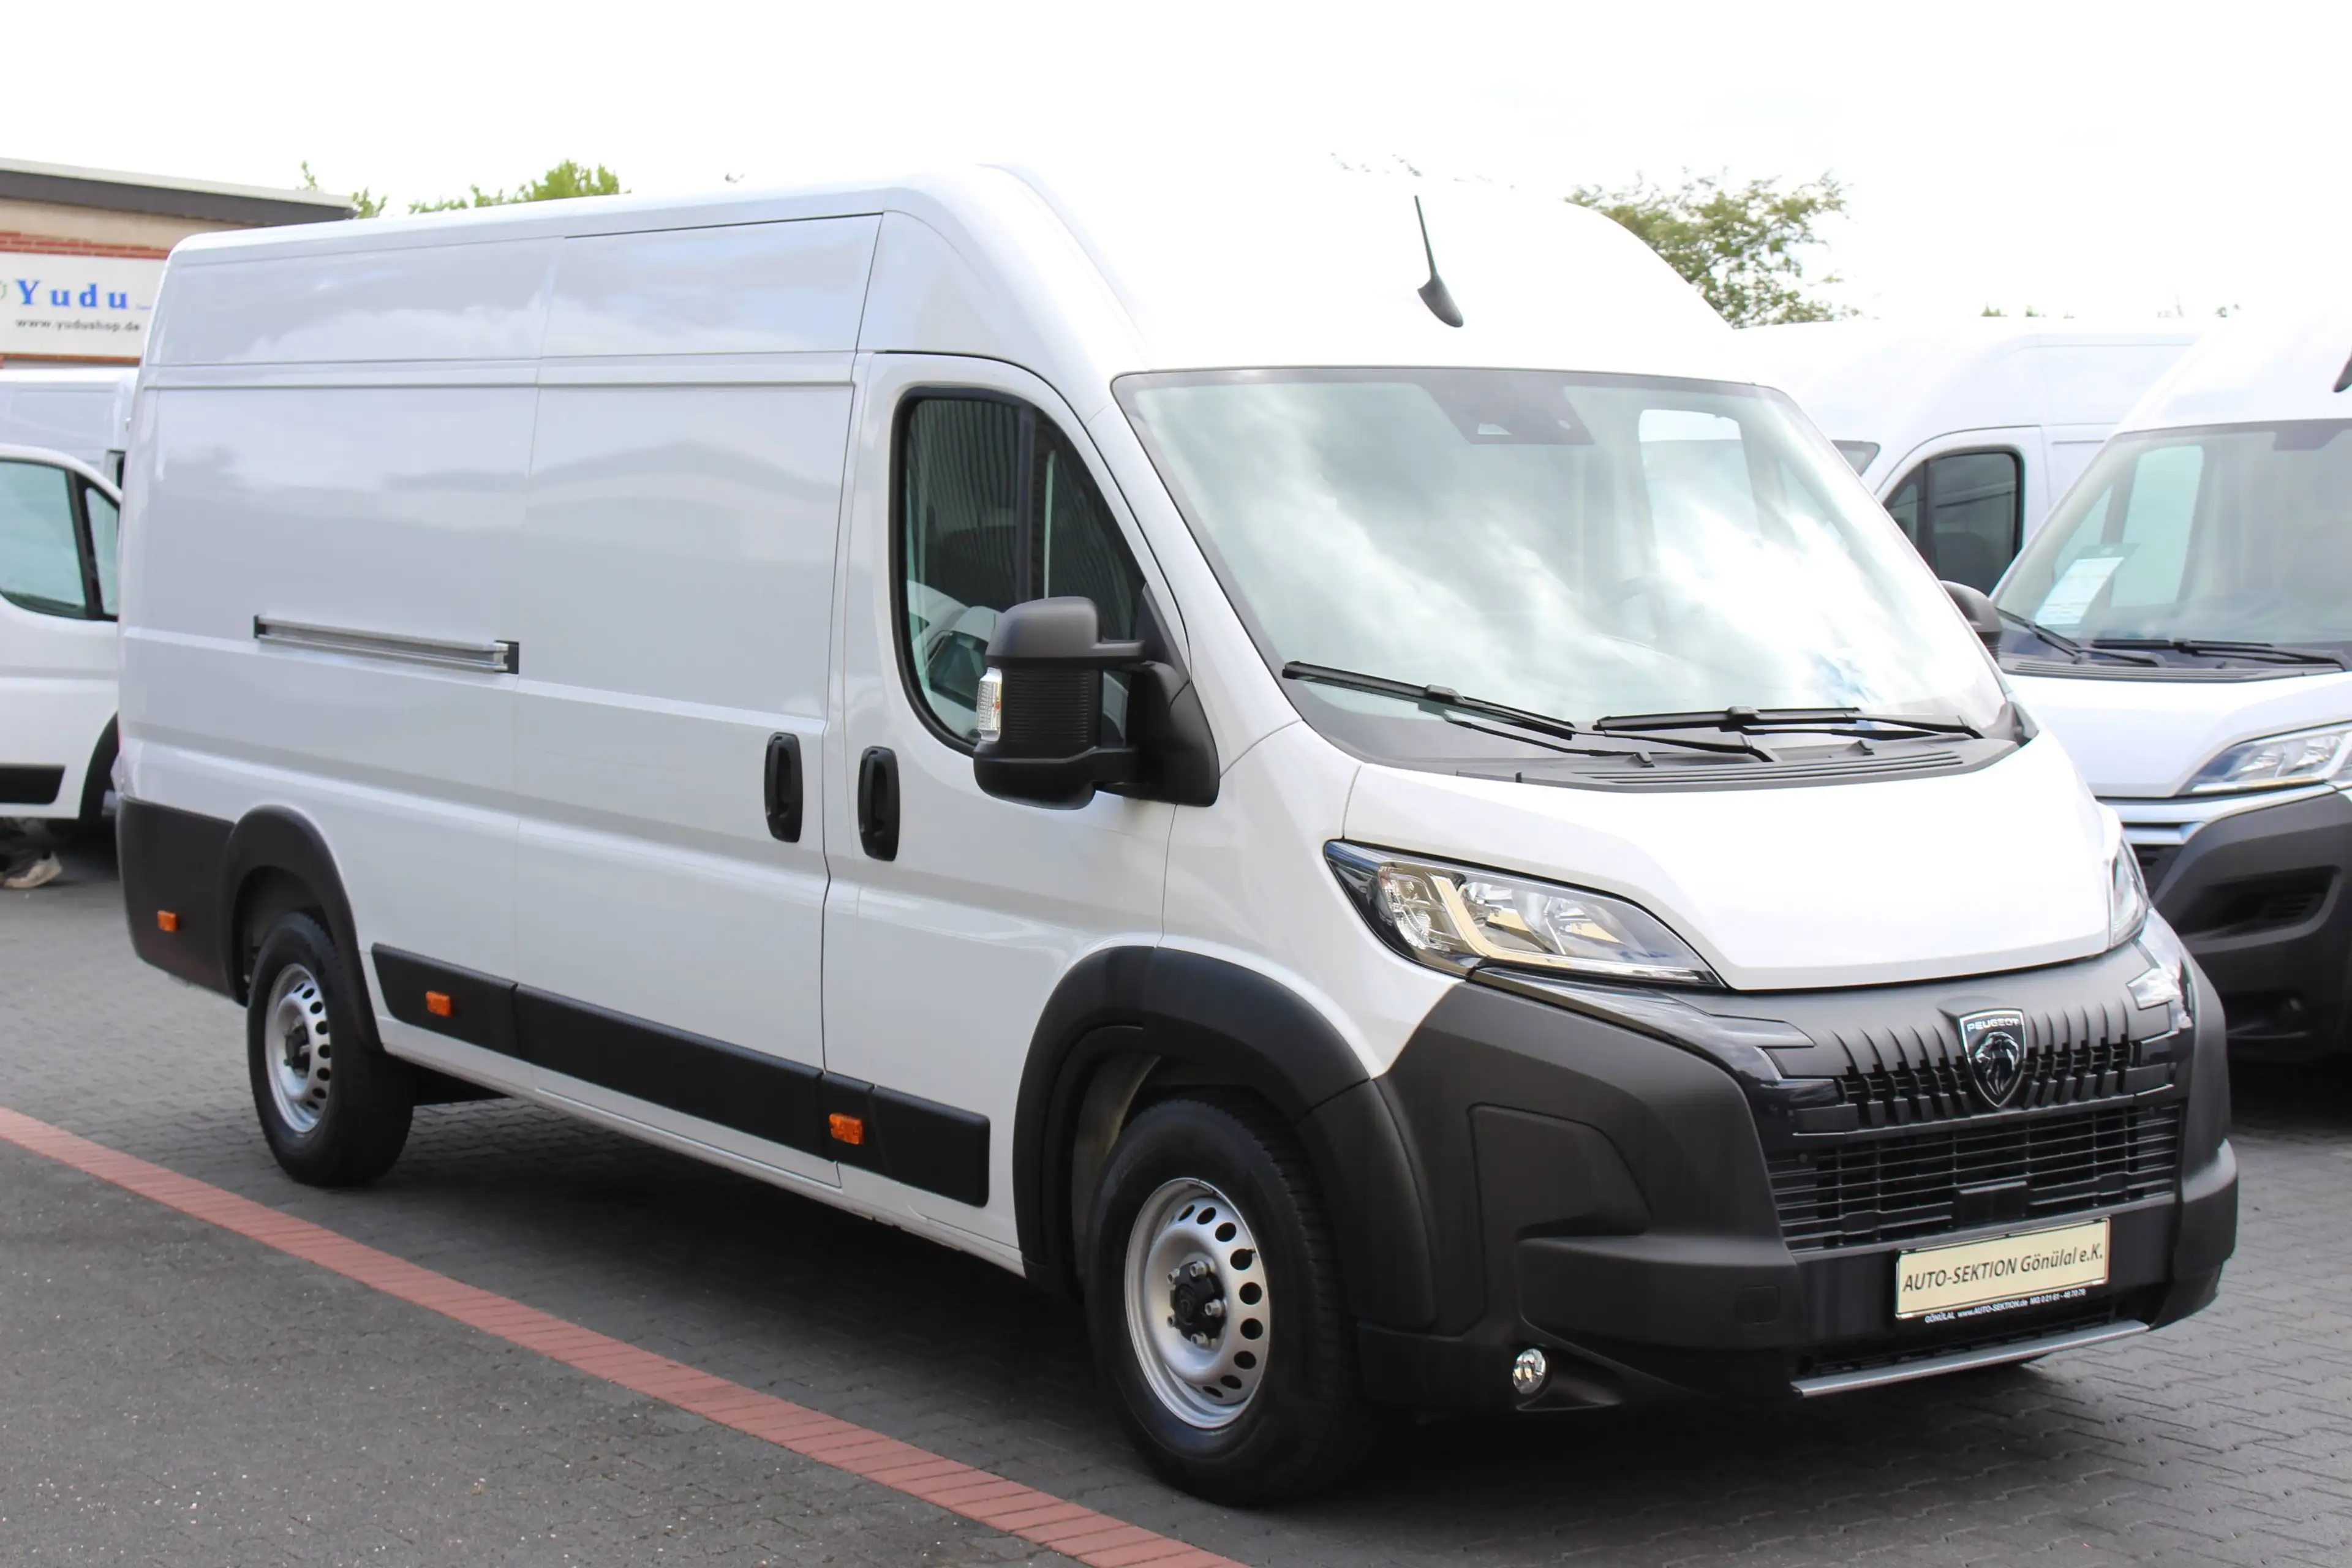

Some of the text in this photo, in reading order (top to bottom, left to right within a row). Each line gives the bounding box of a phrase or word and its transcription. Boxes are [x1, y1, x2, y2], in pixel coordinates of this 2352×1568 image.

[16, 279, 128, 309] Yudu
[16, 318, 140, 333] www.yudushop.de
[1966, 1017, 2020, 1032] PEUGEOT
[1902, 1242, 2103, 1292] AUTO-SEKTION Gönülal e.K.
